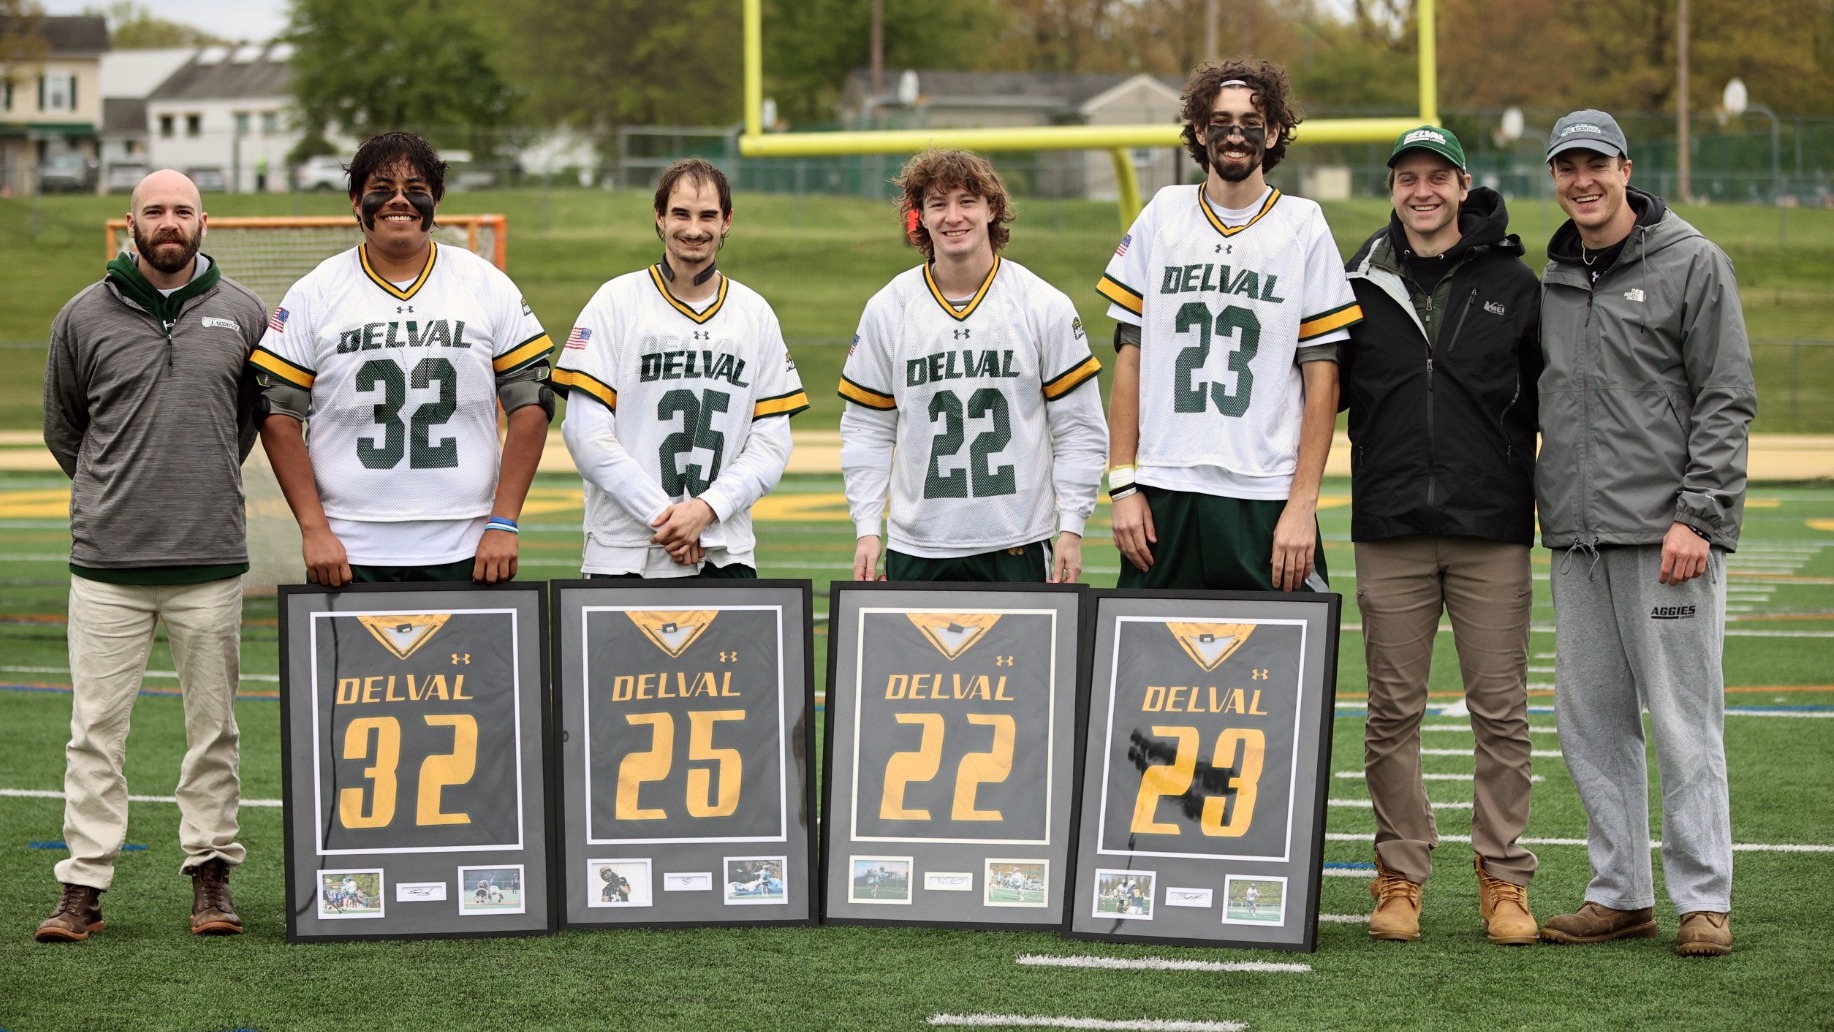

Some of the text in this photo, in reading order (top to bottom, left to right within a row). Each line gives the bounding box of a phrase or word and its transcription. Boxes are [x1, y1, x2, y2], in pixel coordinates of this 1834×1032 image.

[1160, 264, 1285, 303] DELVAL
[337, 319, 472, 354] DELVAL
[640, 350, 749, 388] DELVAL
[907, 350, 1020, 387] DELVAL
[1174, 302, 1261, 418] 23
[356, 358, 458, 469] 32
[658, 388, 730, 497] 25
[924, 388, 1016, 499] 22
[1651, 605, 1696, 616] AGGIES
[336, 674, 474, 705] DELVAL
[612, 672, 741, 701] DELVAL
[885, 674, 1014, 701] DELVAL
[1142, 686, 1268, 715] DELVAL
[339, 714, 478, 828] 32
[615, 710, 746, 820] 25
[879, 713, 1016, 821] 22
[1130, 726, 1266, 837] 23
